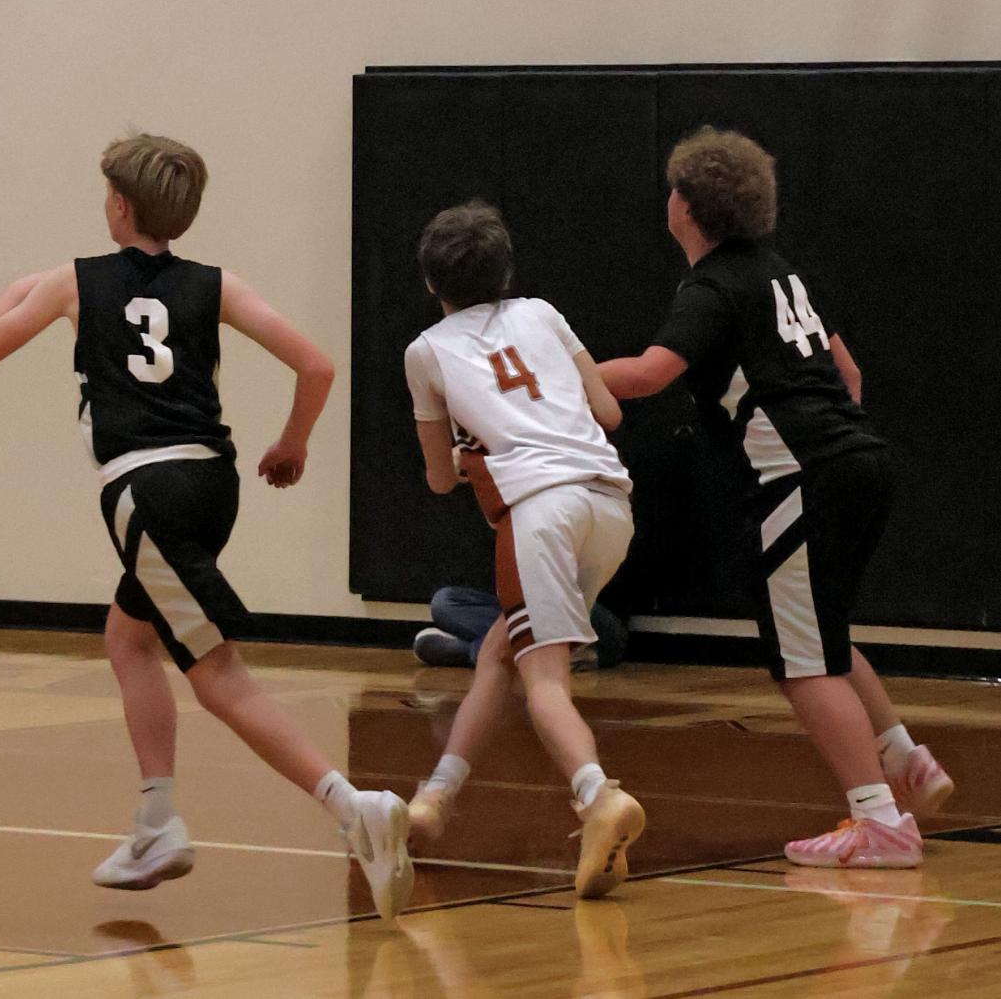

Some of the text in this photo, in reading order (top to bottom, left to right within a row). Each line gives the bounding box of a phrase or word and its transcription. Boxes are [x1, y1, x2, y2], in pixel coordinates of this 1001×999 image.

[124, 296, 175, 384] 3
[771, 273, 831, 358] 44
[487, 344, 546, 402] 4
